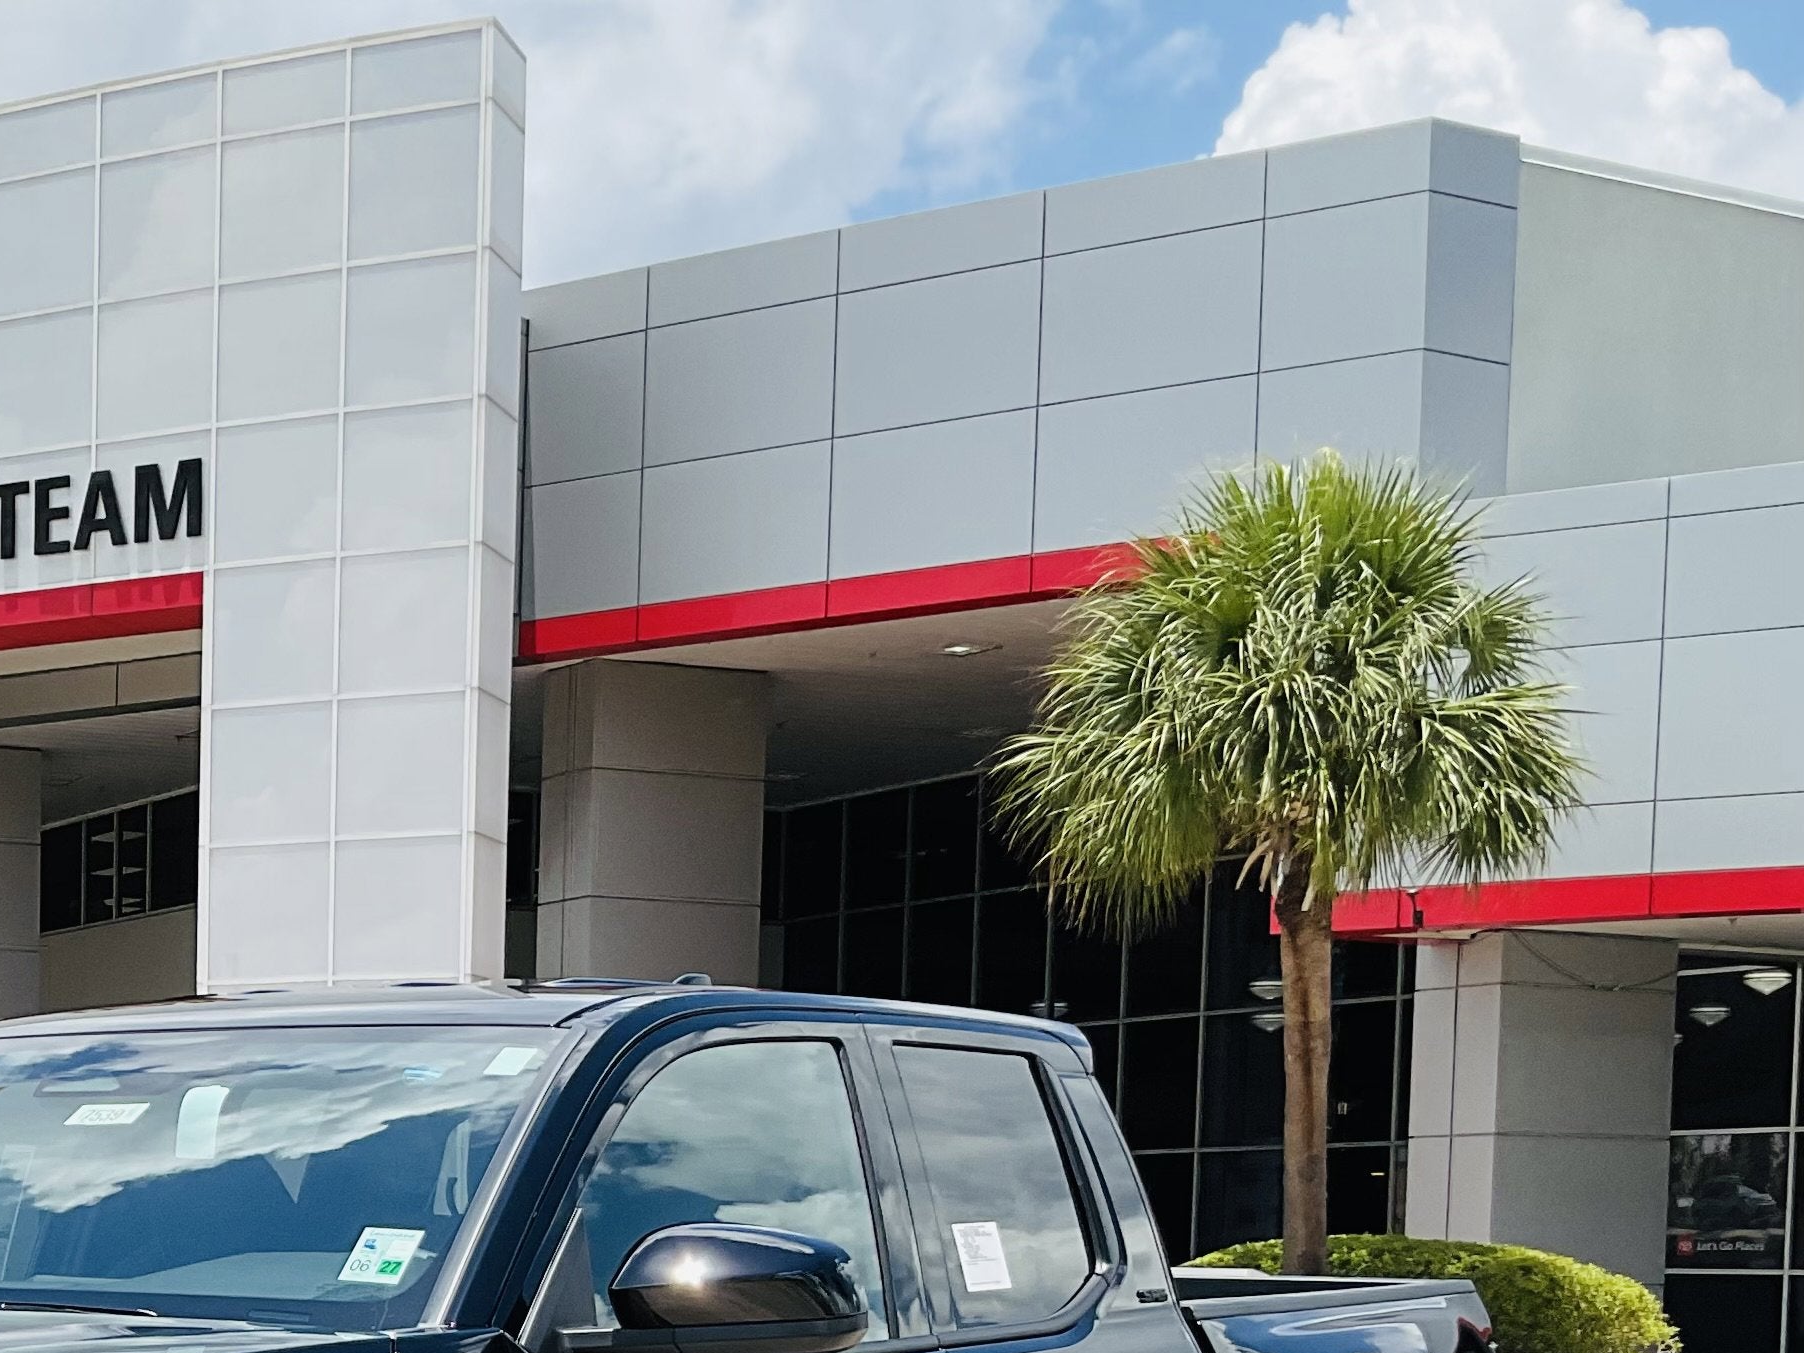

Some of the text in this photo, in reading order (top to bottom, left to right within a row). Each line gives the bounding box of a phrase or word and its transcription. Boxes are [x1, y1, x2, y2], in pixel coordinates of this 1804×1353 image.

[1719, 1241, 1733, 1251] Go
[350, 1259, 403, 1273] 06 27
